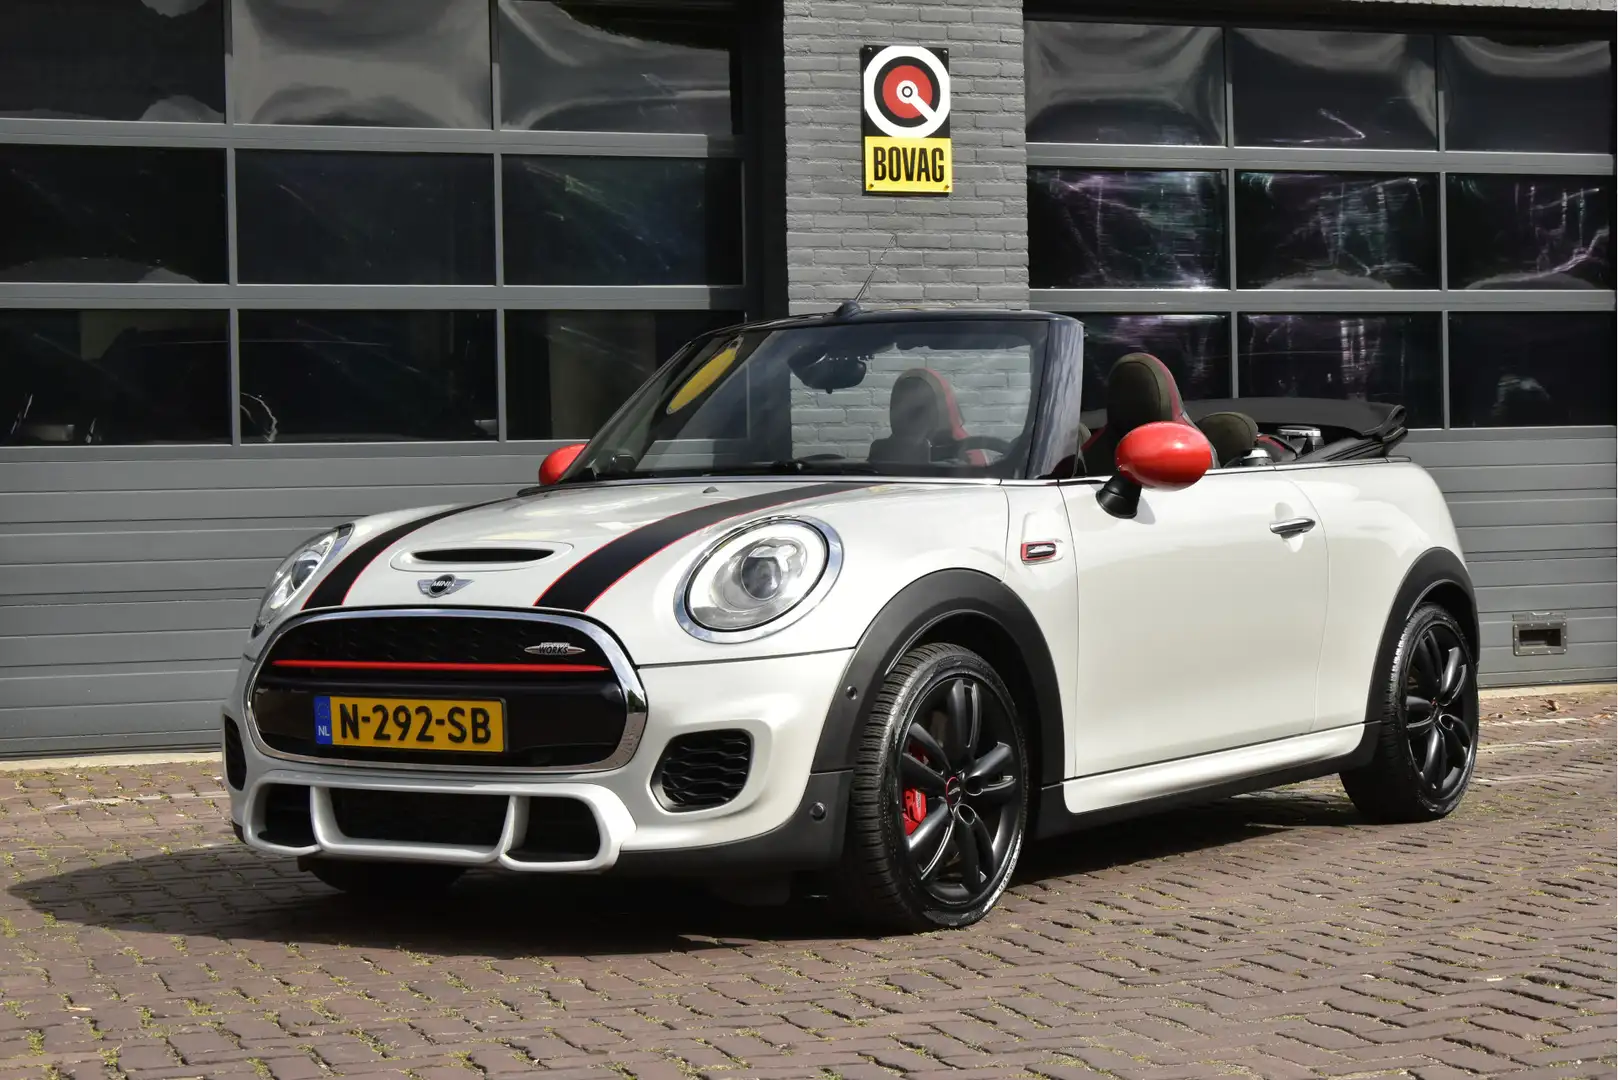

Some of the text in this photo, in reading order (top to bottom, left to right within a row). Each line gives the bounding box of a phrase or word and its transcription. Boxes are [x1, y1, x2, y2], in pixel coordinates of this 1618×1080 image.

[873, 146, 945, 183] BOVAG
[540, 646, 569, 655] WORKS
[318, 725, 330, 736] NL
[339, 703, 492, 745] N-292-SB
